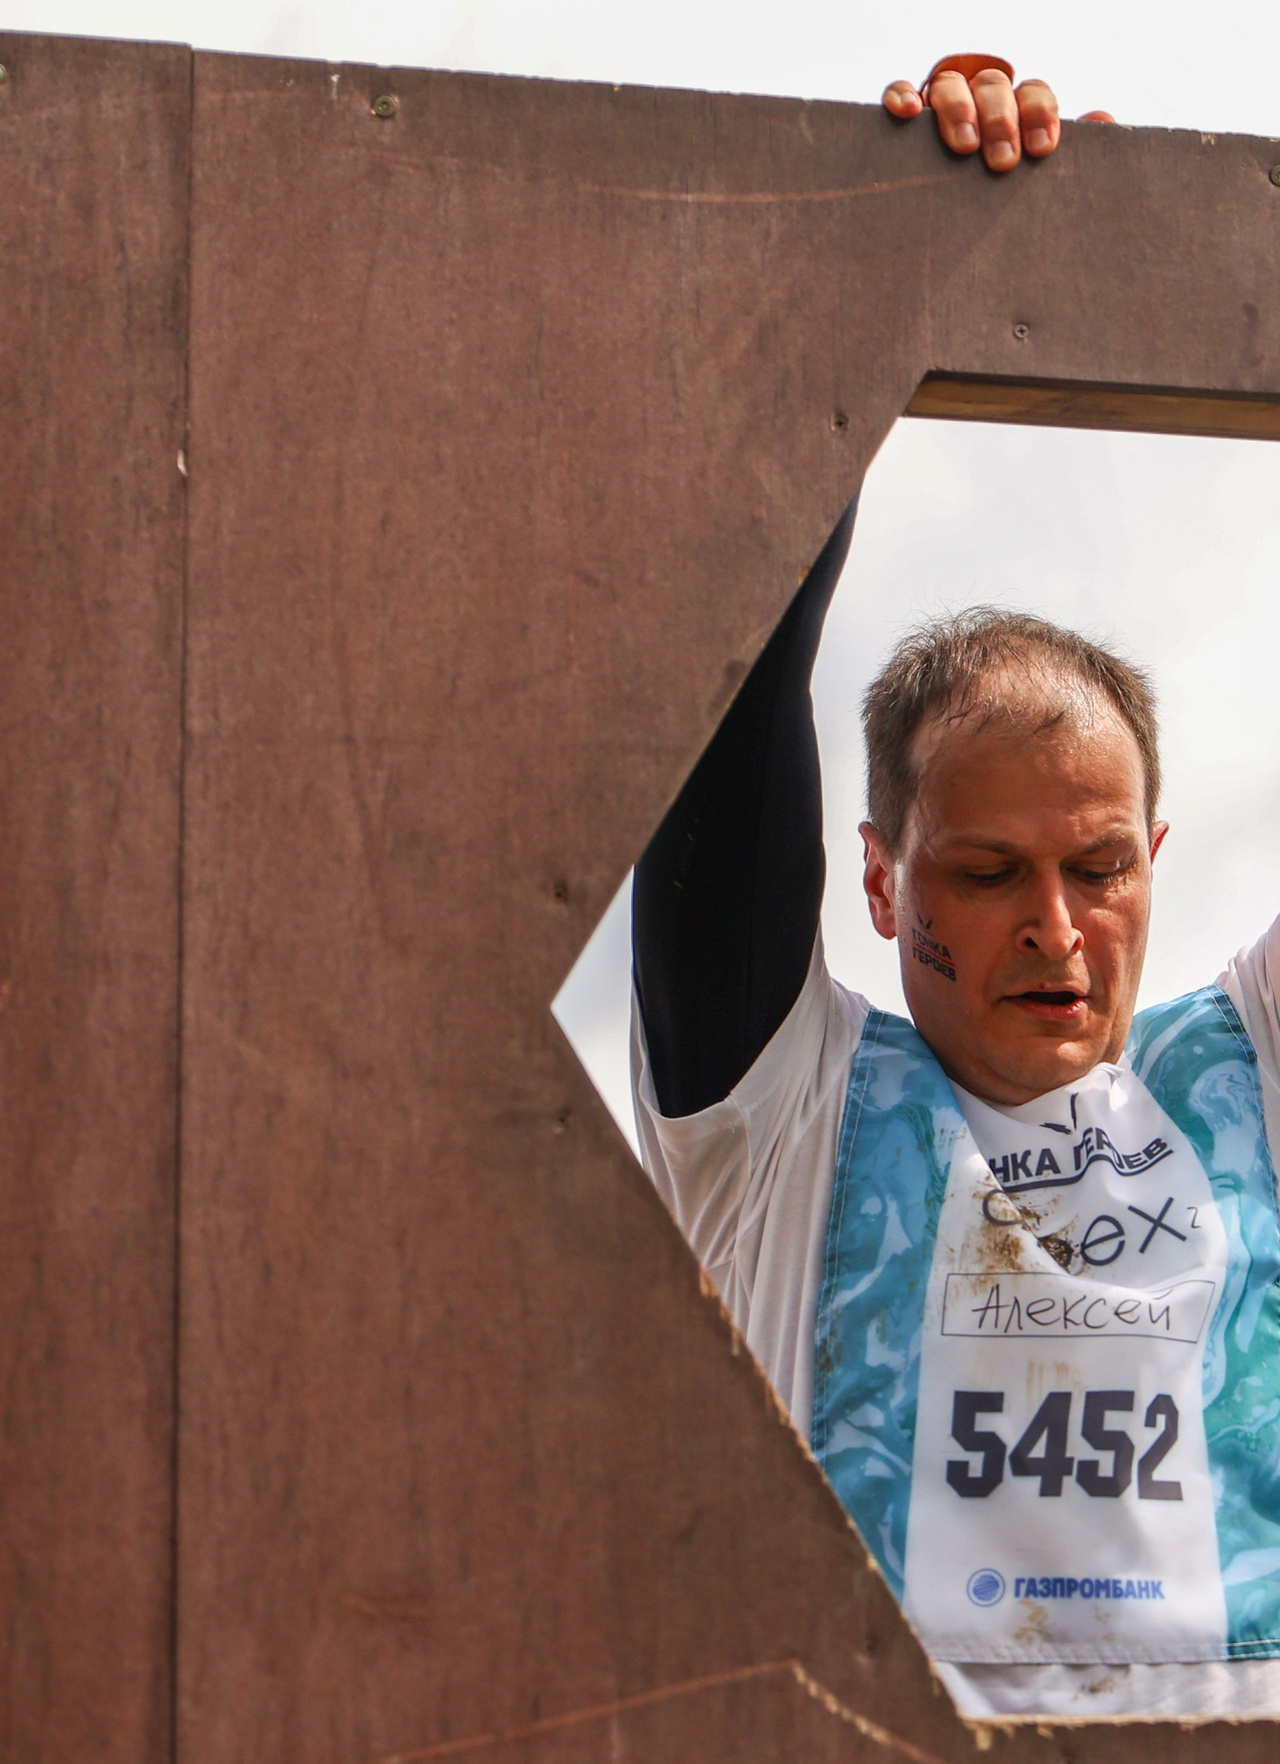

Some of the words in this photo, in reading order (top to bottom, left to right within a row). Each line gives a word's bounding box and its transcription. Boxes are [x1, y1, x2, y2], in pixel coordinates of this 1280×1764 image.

[912, 947, 957, 981] ГЕРОЕВ
[988, 1148, 1062, 1183] НКА
[971, 1283, 1175, 1334] Алексей
[946, 1389, 1184, 1501] 5452
[1014, 1577, 1166, 1600] ГАЗПРОМБАНК
